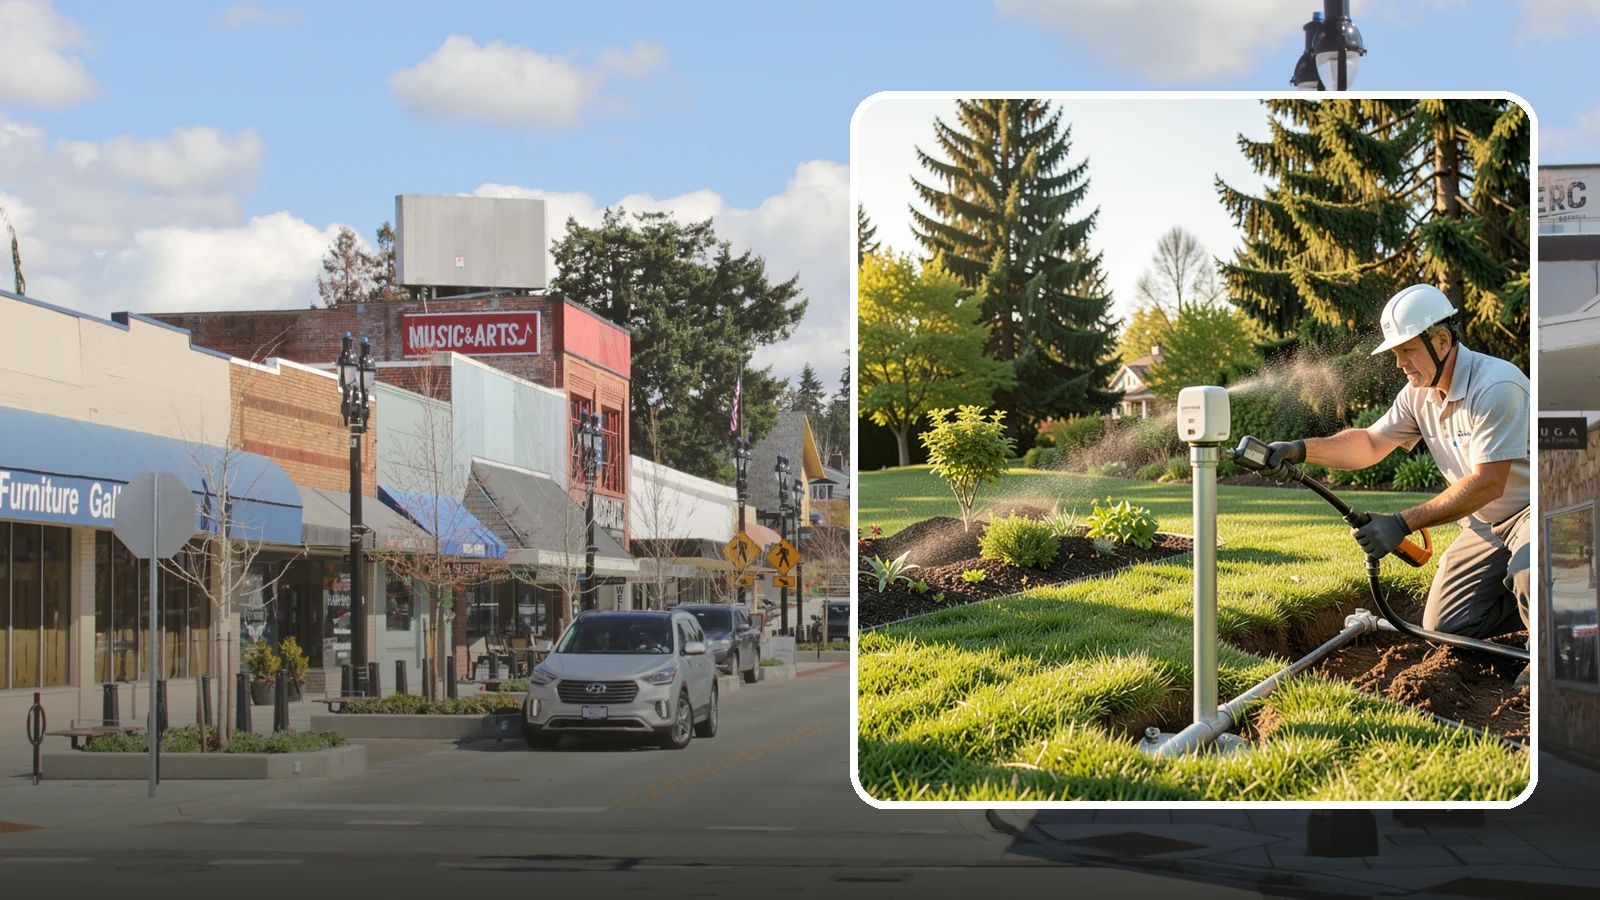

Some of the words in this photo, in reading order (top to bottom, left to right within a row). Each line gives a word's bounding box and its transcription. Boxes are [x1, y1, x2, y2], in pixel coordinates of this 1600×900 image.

[1540, 427, 1577, 437] UGA
[0, 471, 79, 515] Furniture
[89, 482, 122, 519] Gal
[453, 563, 479, 574] SUSHI
